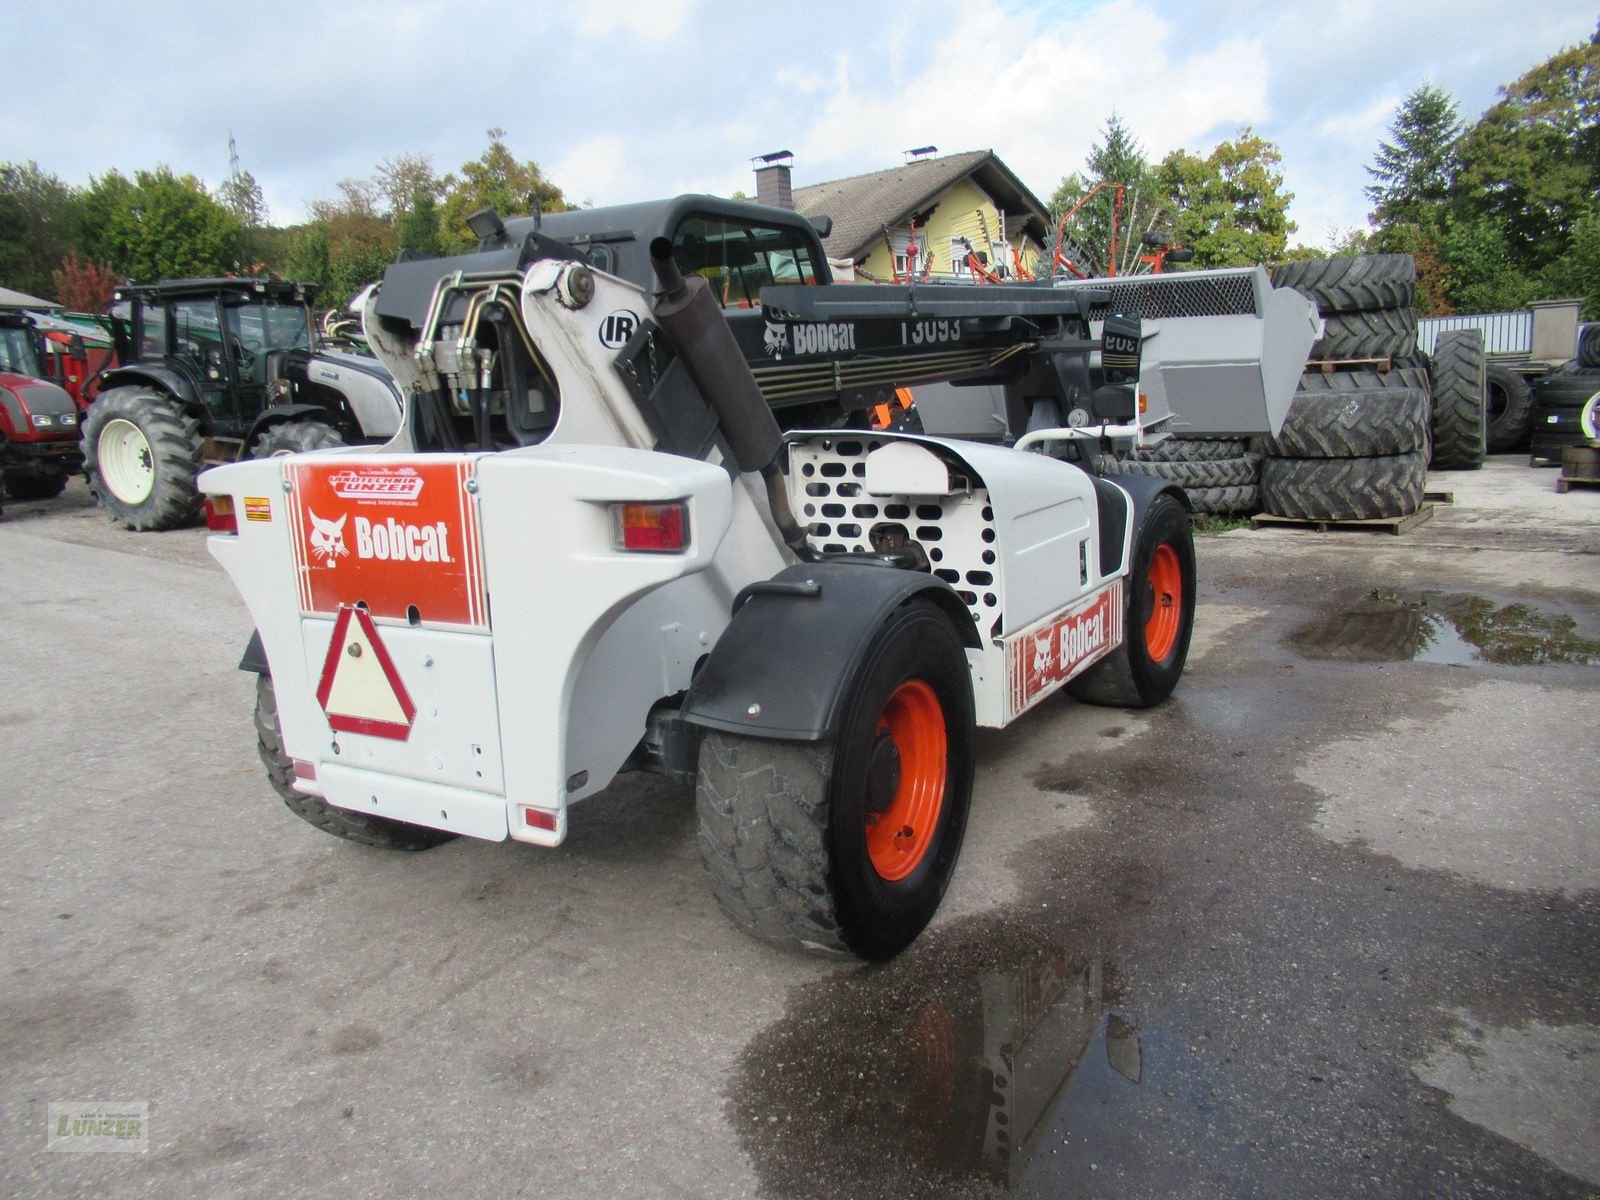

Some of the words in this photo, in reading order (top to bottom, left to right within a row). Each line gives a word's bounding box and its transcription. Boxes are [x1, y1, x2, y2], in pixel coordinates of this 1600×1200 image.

[606, 316, 633, 342] IR
[793, 323, 856, 354] Bobcat
[355, 516, 450, 562] Bobcat
[1060, 605, 1104, 670] Bobcat
